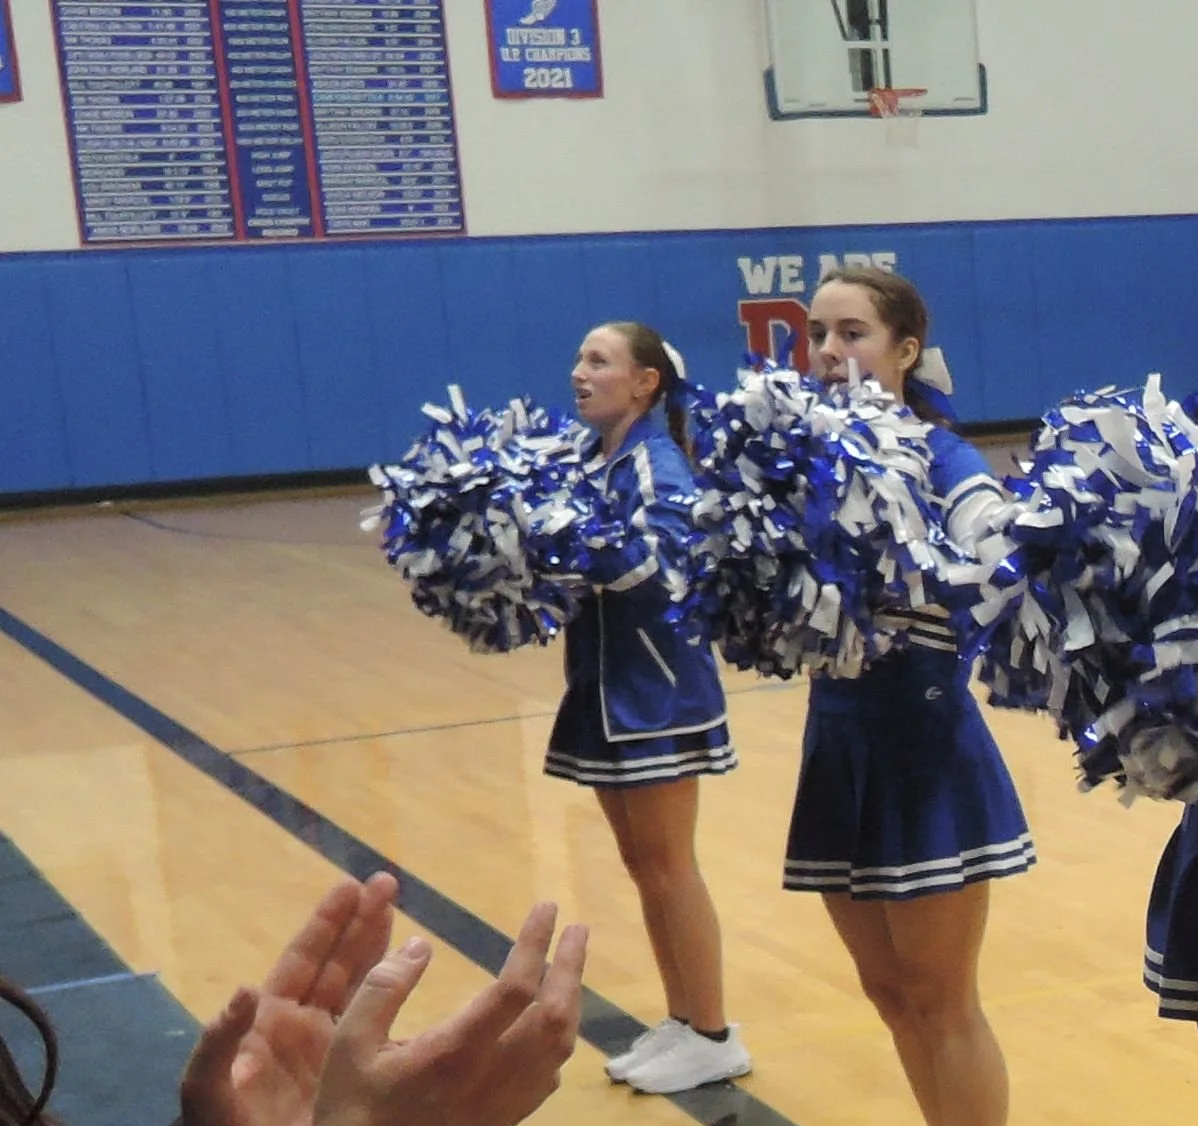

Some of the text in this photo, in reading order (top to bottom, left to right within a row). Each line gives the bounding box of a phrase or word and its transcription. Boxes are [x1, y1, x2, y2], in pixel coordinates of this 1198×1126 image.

[506, 28, 580, 46] DIVISION 3
[525, 47, 592, 62] CHAMPIONS
[523, 67, 573, 89] 2021
[737, 255, 806, 294] WE
